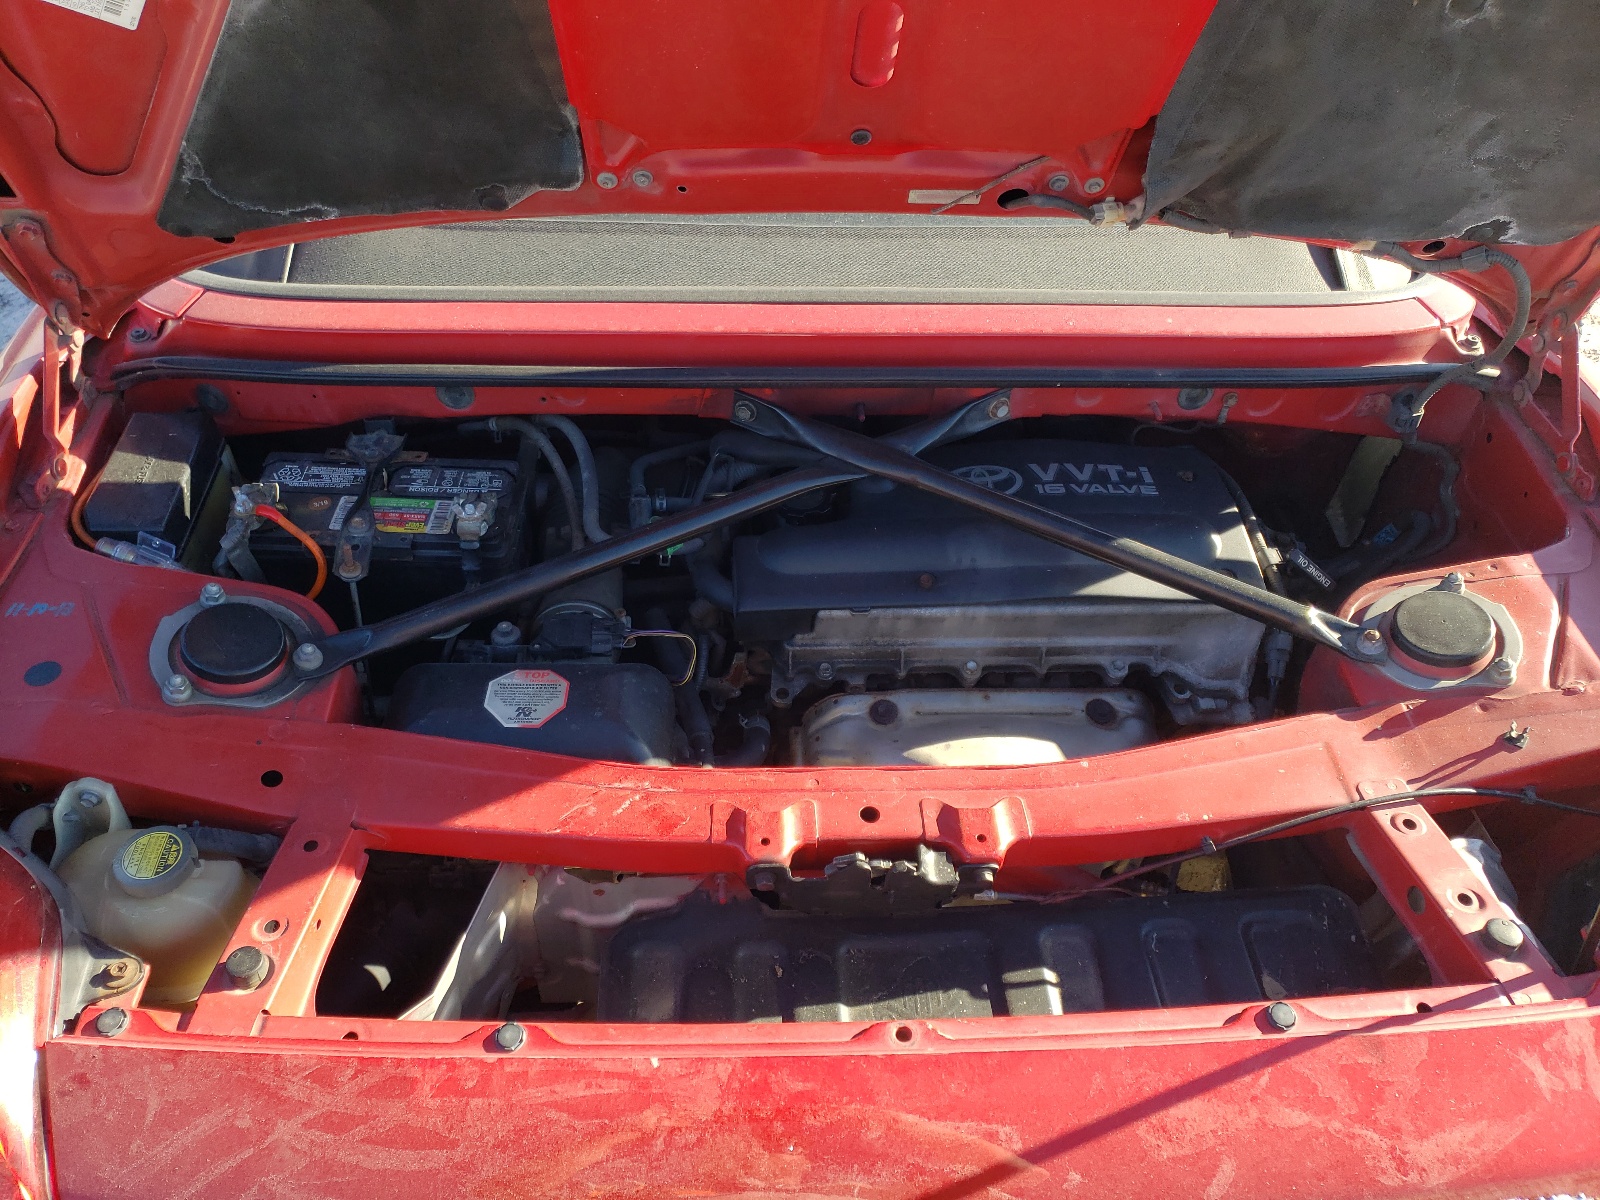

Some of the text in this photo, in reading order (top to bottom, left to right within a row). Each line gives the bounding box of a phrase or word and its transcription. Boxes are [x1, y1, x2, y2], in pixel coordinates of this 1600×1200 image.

[1027, 463, 1154, 483] VVT-i
[1035, 483, 1159, 496] 16 VALVE
[1297, 555, 1331, 588] ENGINE OIL
[514, 671, 550, 679] STOP
[156, 838, 174, 872] CAUTION
